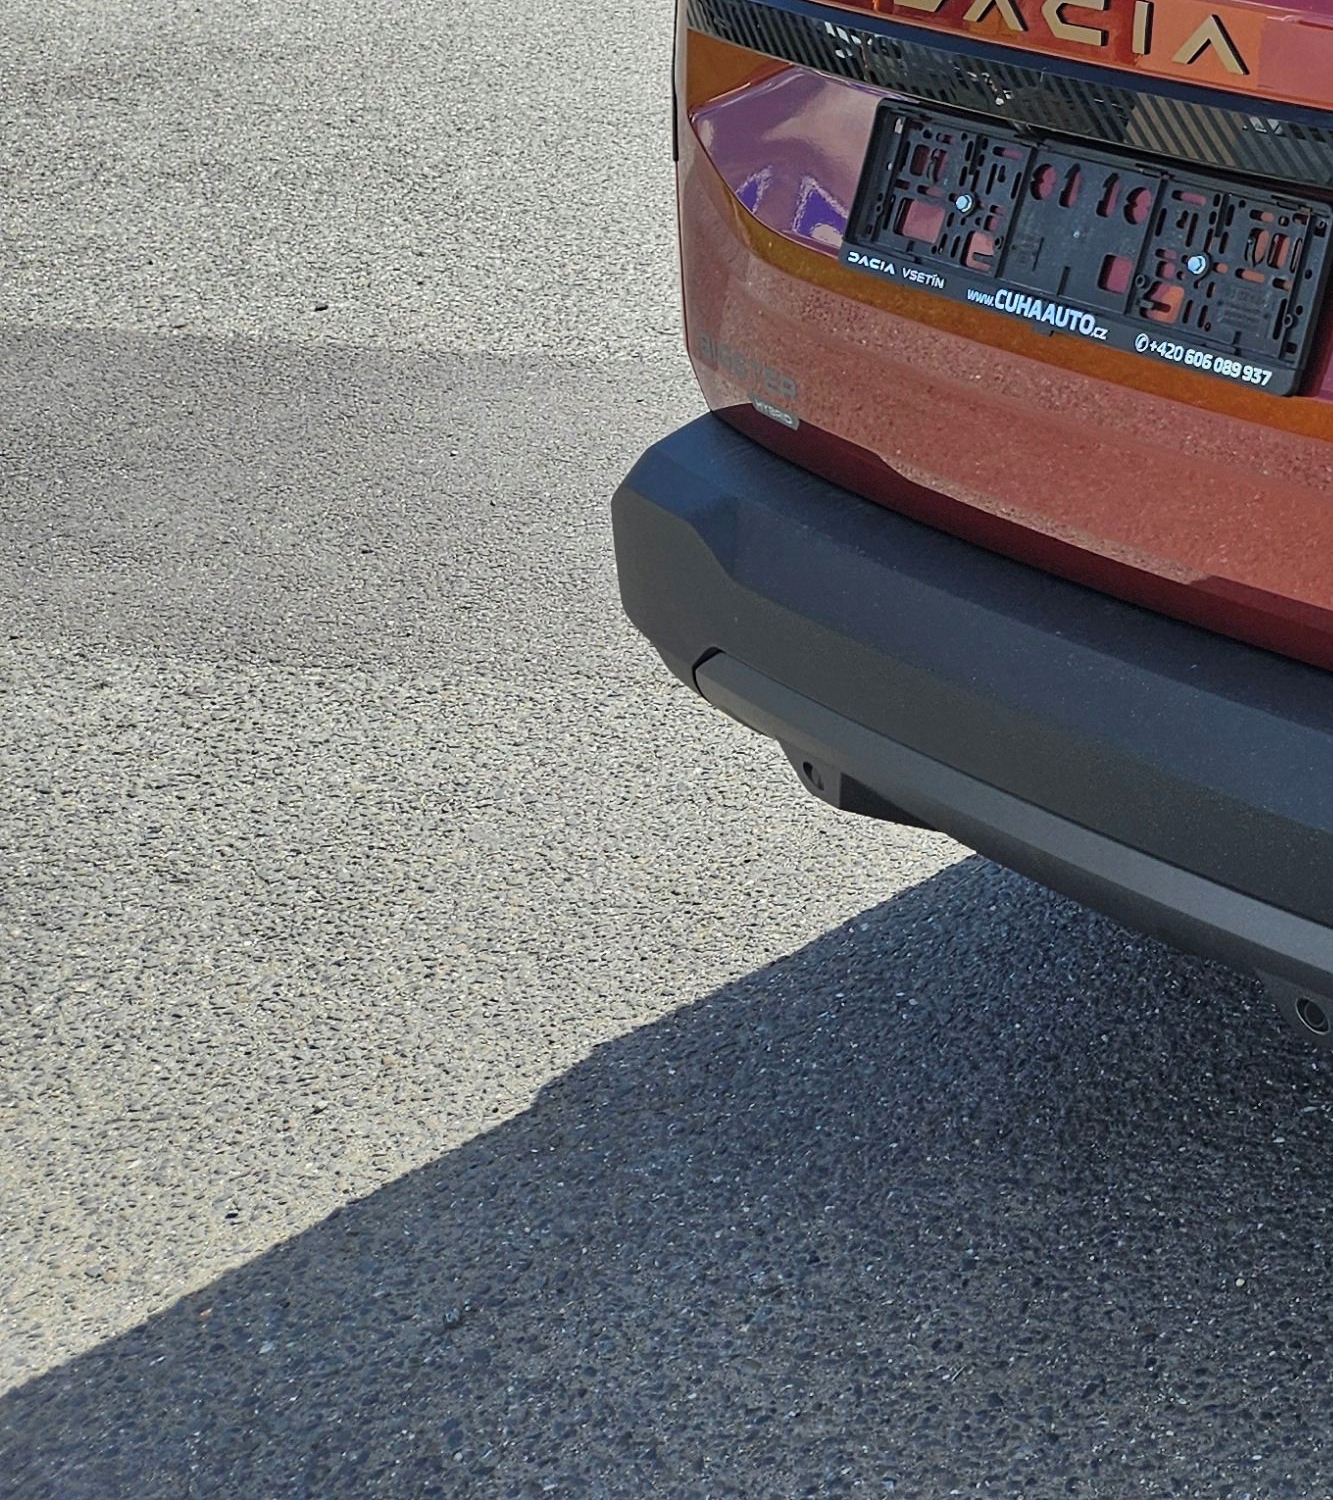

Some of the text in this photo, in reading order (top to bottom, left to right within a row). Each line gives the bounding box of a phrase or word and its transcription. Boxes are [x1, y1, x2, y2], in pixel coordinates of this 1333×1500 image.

[847, 251, 945, 289] DACIA VSETÍN
[967, 288, 1108, 340] www.CUHAAUTO.cz
[1150, 340, 1272, 387] +420 606 089 937
